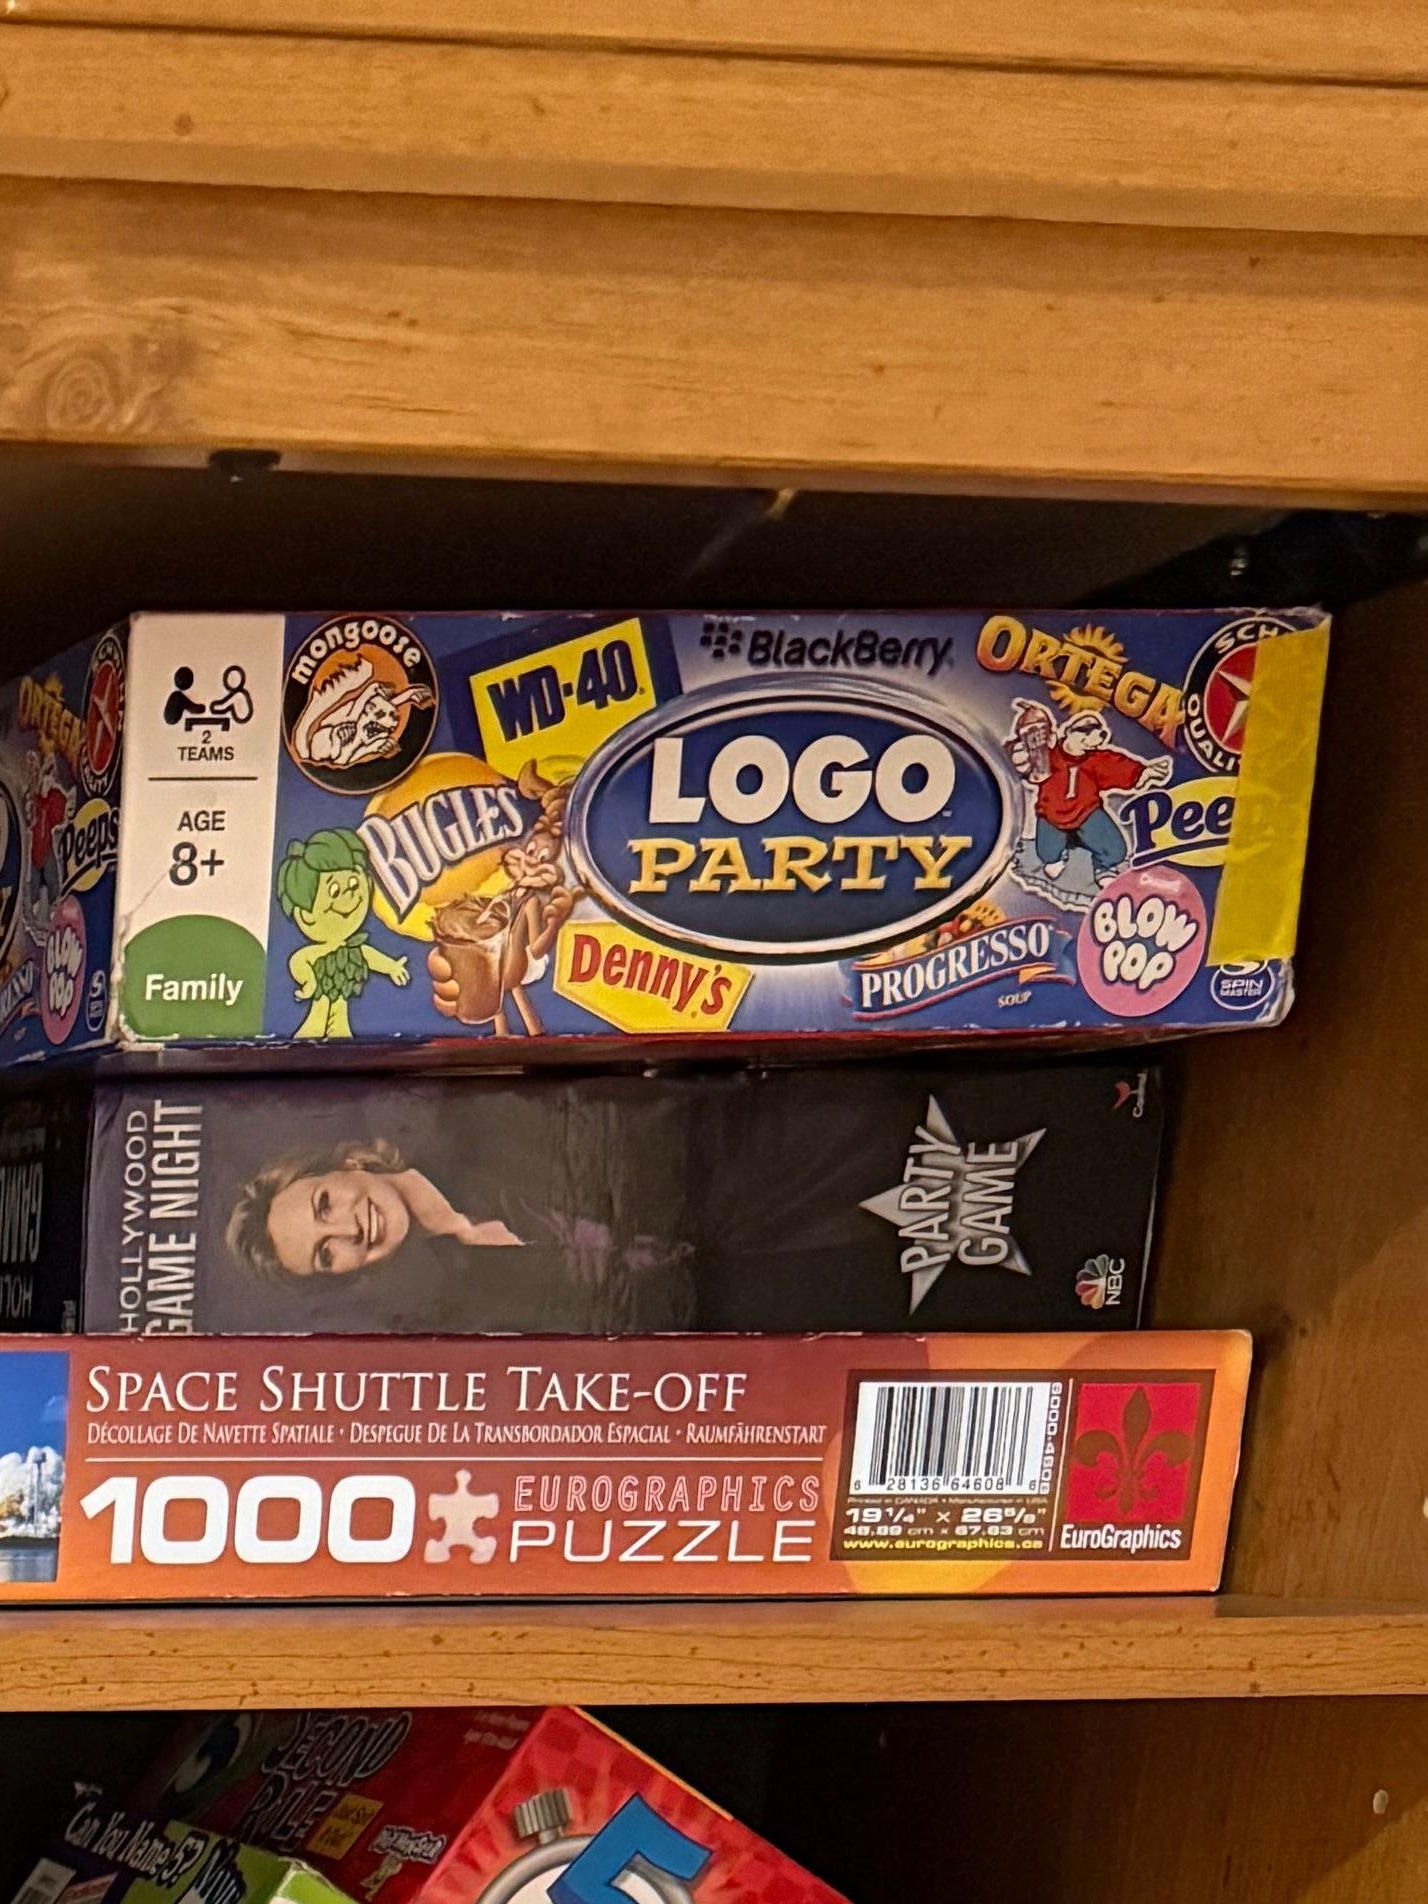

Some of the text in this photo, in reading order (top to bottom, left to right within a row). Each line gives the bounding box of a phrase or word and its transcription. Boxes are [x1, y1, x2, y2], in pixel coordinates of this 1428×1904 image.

[292, 618, 422, 685] mongoose
[486, 638, 644, 742] WD-40
[177, 746, 234, 762] TEAMS
[649, 734, 956, 825] LOGO
[177, 810, 226, 832] AGE
[168, 842, 225, 886] 8+
[628, 835, 973, 894] PARTY
[145, 973, 243, 1006] Family
[571, 933, 734, 1017] Denny's
[120, 1110, 147, 1334] HOLLYWOOD
[146, 1100, 202, 1336] GAME NIGHT
[899, 1125, 961, 1273] PARTY
[958, 1141, 1018, 1266] GAME
[1105, 1258, 1125, 1305] NBC
[86, 1365, 746, 1413] SPACE SHUTTLE TAKE-OFF
[80, 1475, 415, 1565] 1000
[515, 1475, 820, 1512] EUROGRAPHICS
[510, 1520, 813, 1562] PUZZLE
[1061, 1524, 1181, 1553] EuroGraphics
